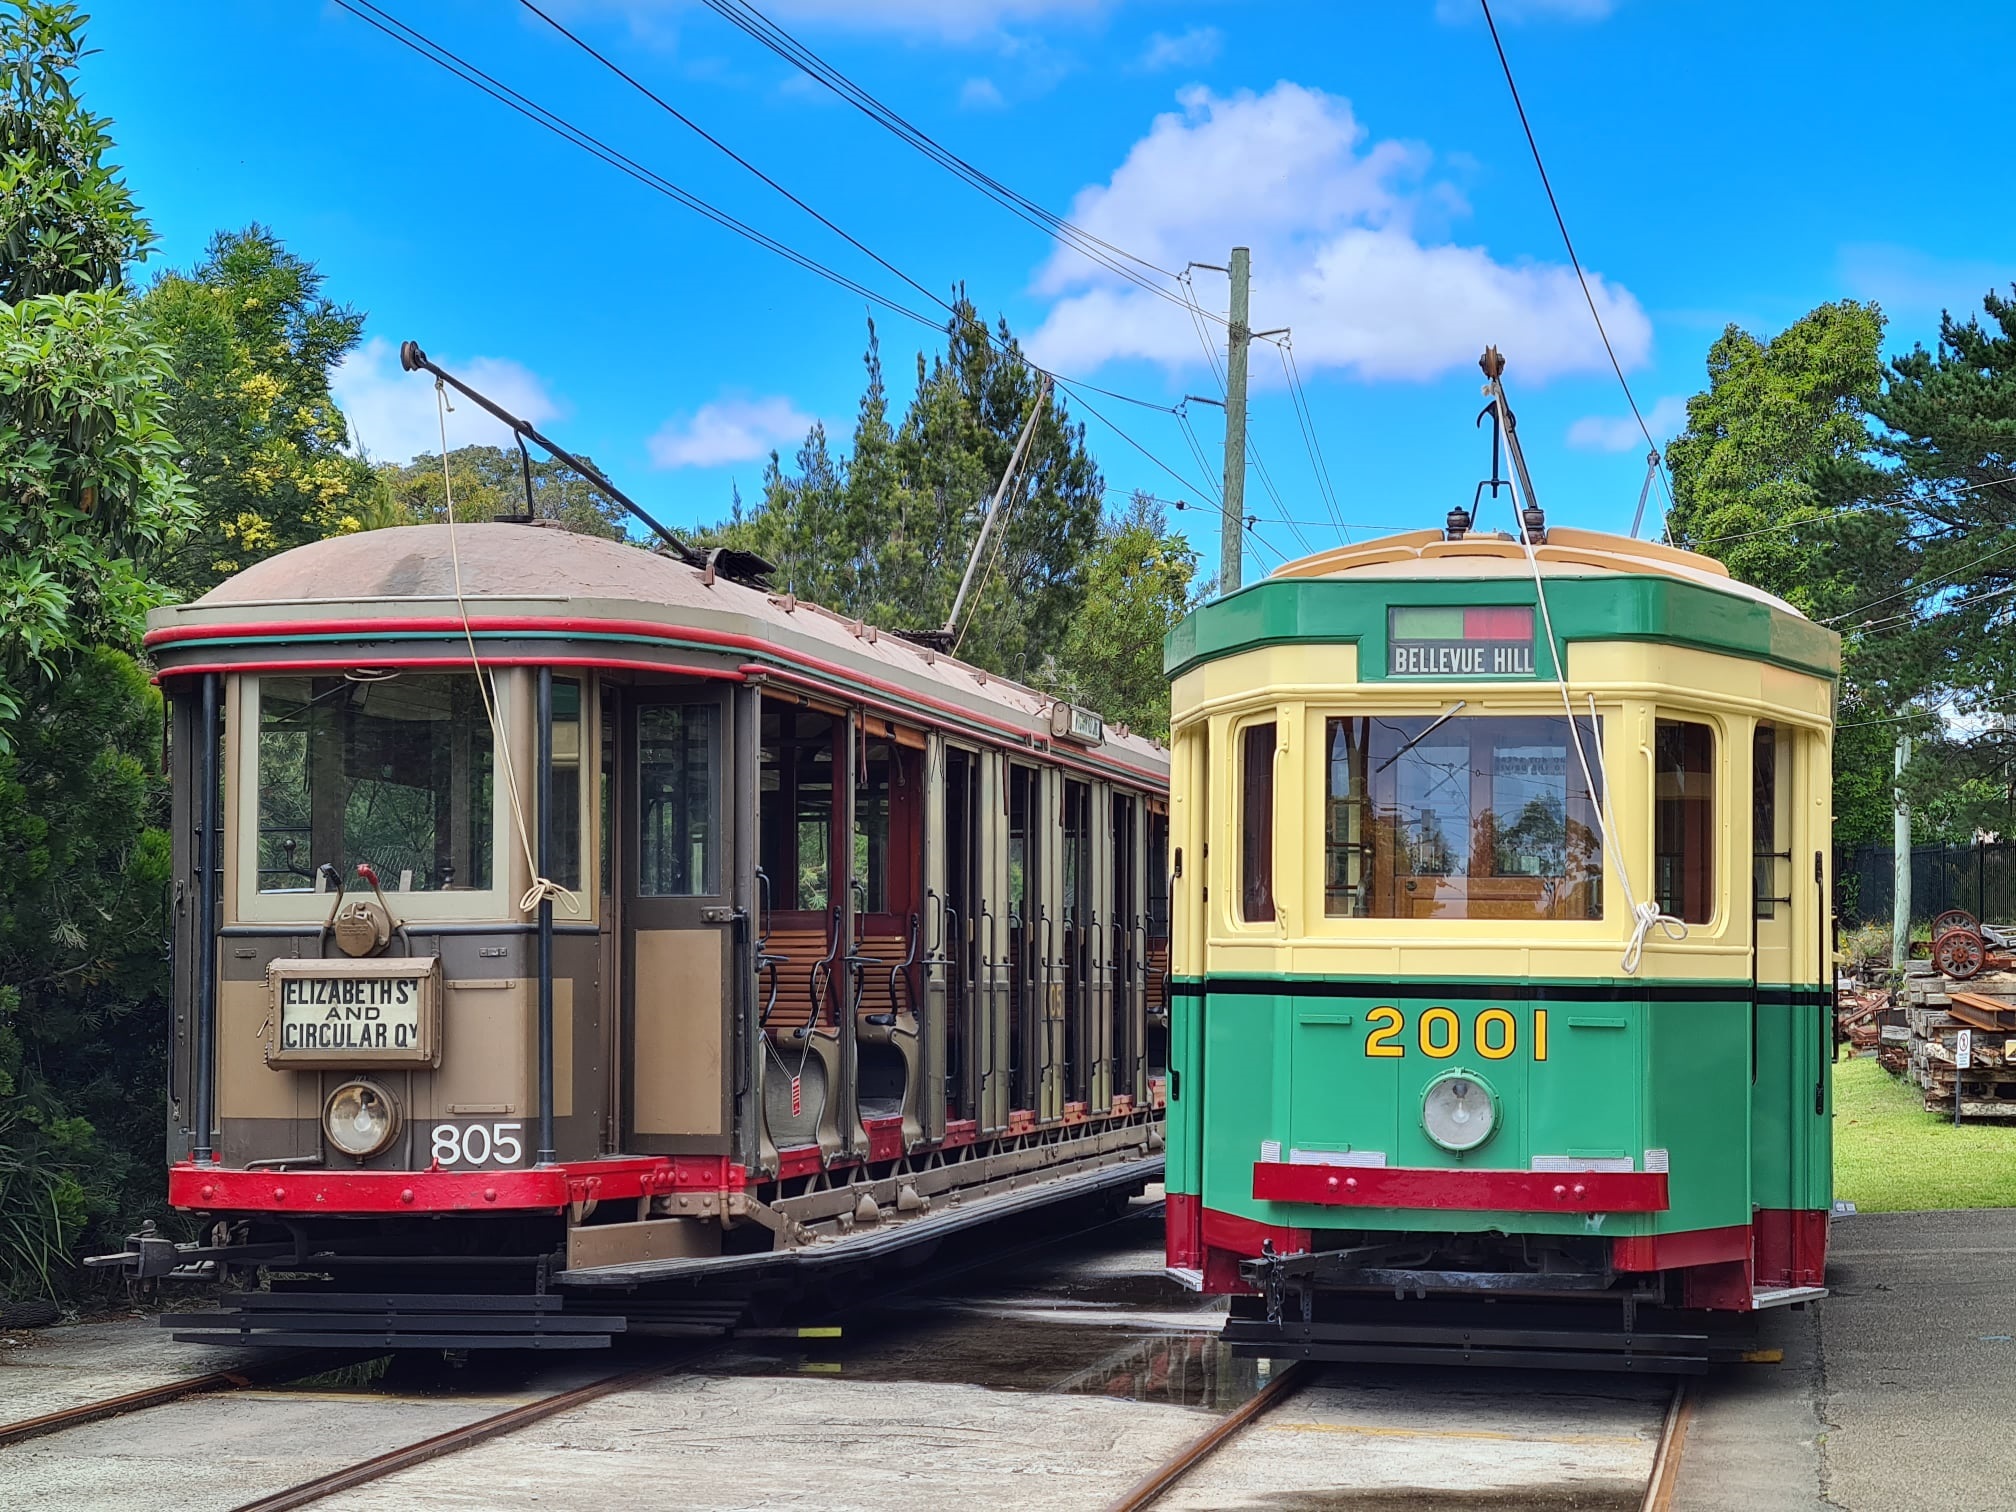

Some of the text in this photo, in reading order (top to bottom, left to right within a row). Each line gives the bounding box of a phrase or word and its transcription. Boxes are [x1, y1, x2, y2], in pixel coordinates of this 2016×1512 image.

[1395, 647, 1535, 673] BELLEVUE HILL
[286, 979, 392, 1005] ELIZABETH
[325, 1007, 380, 1021] AND
[285, 1023, 387, 1049] CIRCULAR
[1365, 1006, 1548, 1062] 2001
[431, 1123, 522, 1166] 805
